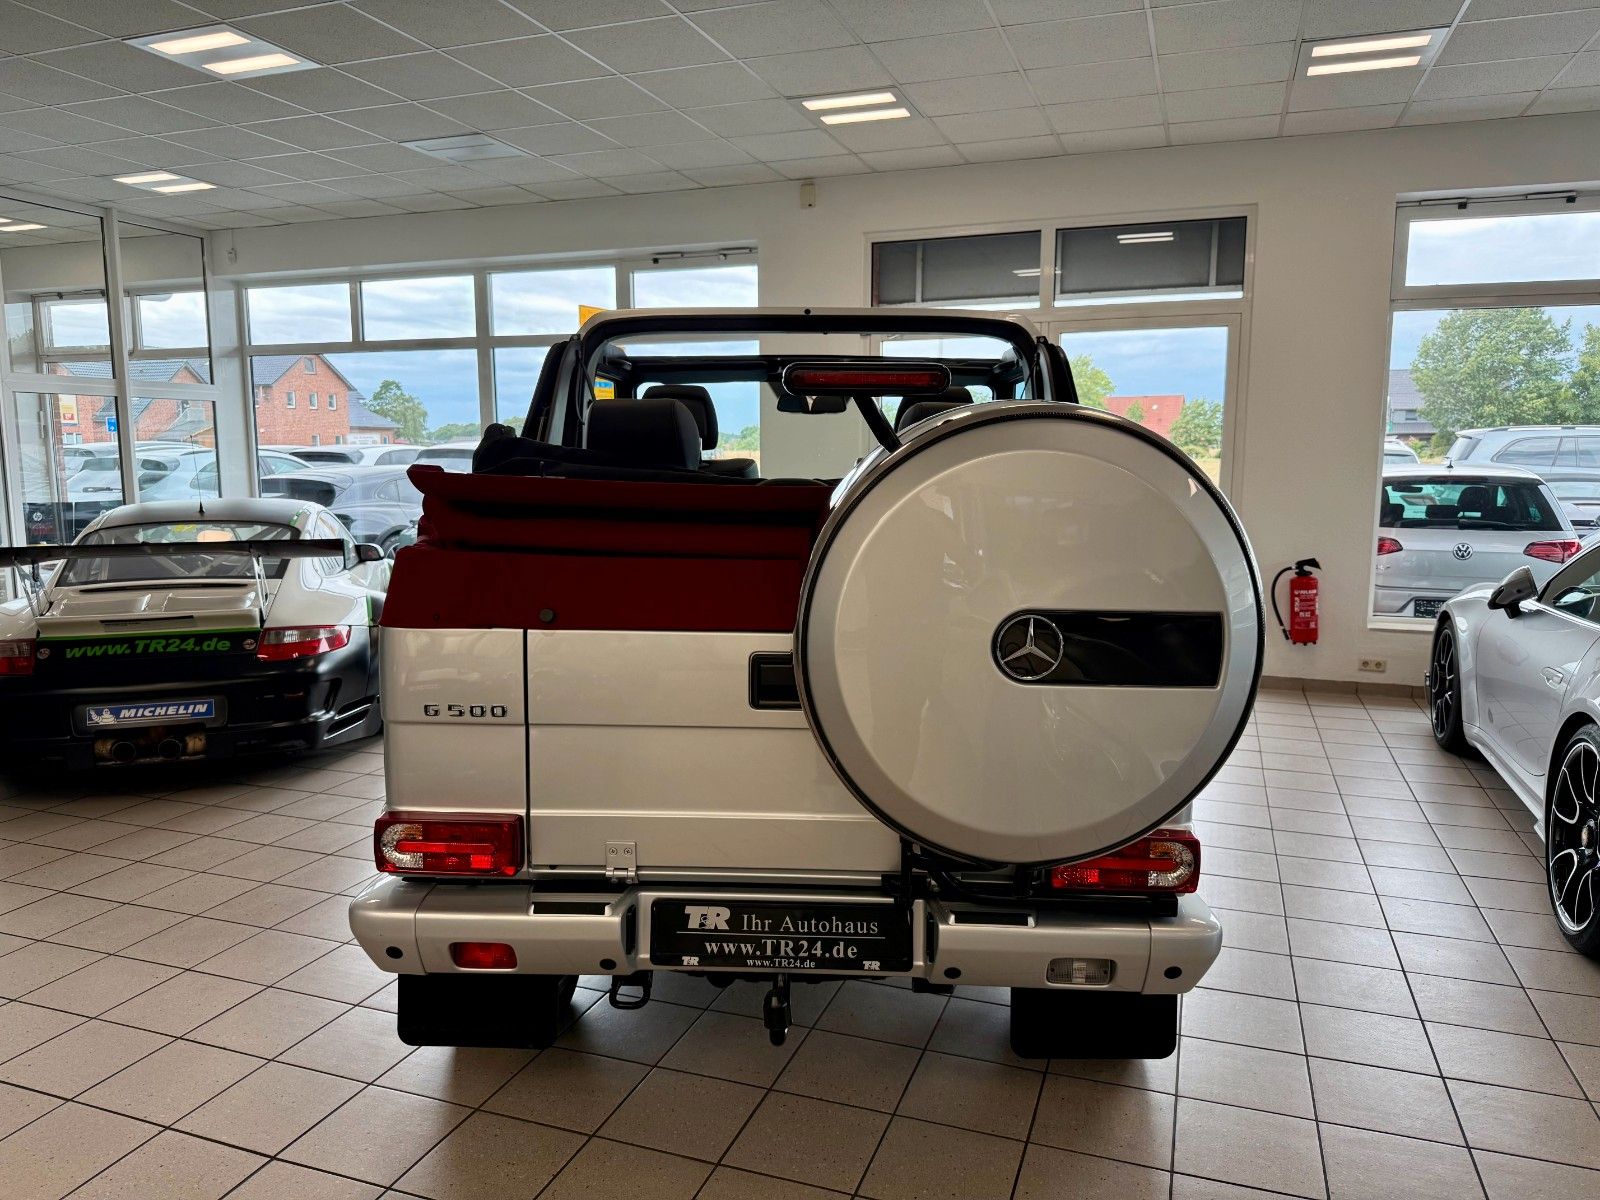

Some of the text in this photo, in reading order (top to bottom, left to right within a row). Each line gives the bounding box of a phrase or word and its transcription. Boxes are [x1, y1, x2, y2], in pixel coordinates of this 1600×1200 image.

[65, 637, 231, 658] www.TR24.de
[119, 703, 208, 718] MICHELIN
[424, 704, 508, 718] G 500
[741, 914, 772, 931] Ihr
[779, 915, 879, 934] Autohaus
[705, 939, 858, 959] www.TR24.de
[746, 958, 816, 969] www.TR24.de
